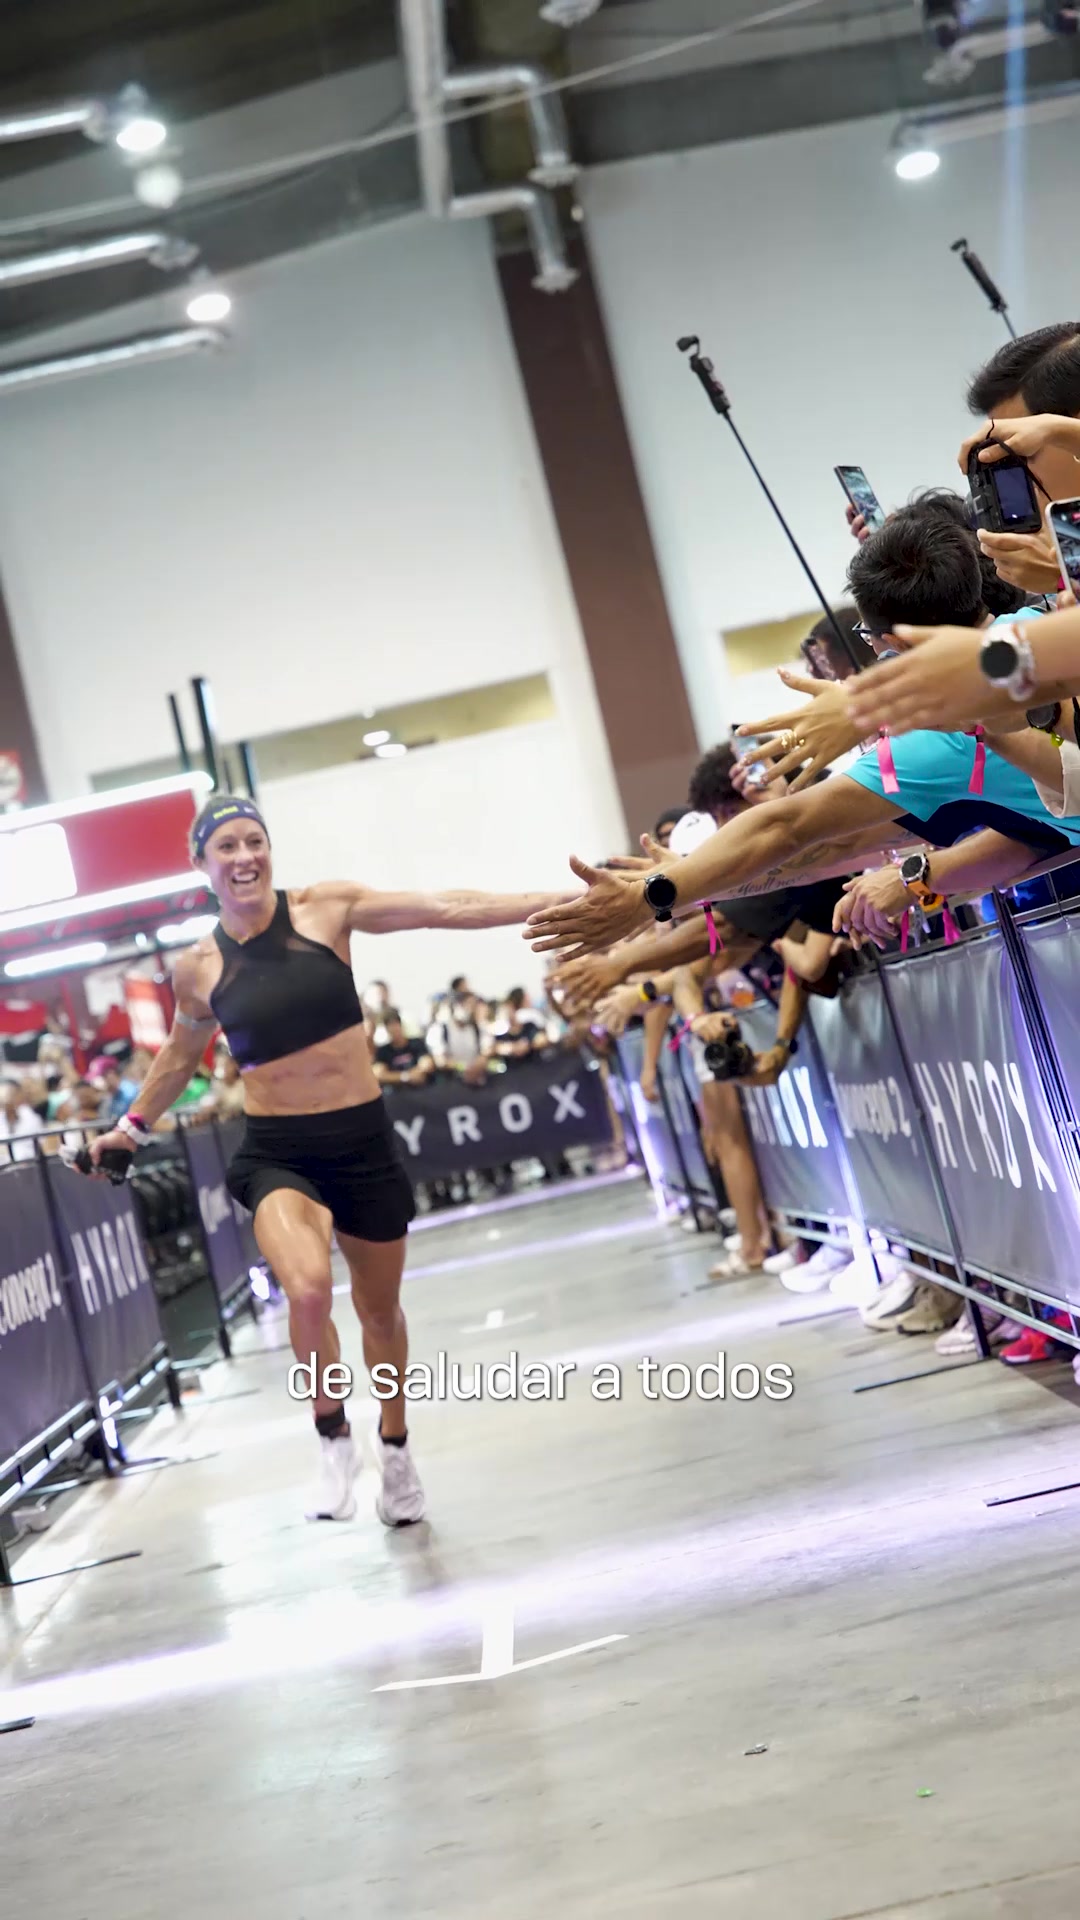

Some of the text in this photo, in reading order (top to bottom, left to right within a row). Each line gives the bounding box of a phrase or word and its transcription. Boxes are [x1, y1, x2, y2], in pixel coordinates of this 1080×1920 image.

[393, 1079, 587, 1156] YROX
[741, 1065, 829, 1149] HYROX
[913, 1059, 1058, 1193] HYROX
[70, 1209, 150, 1315] HYROX
